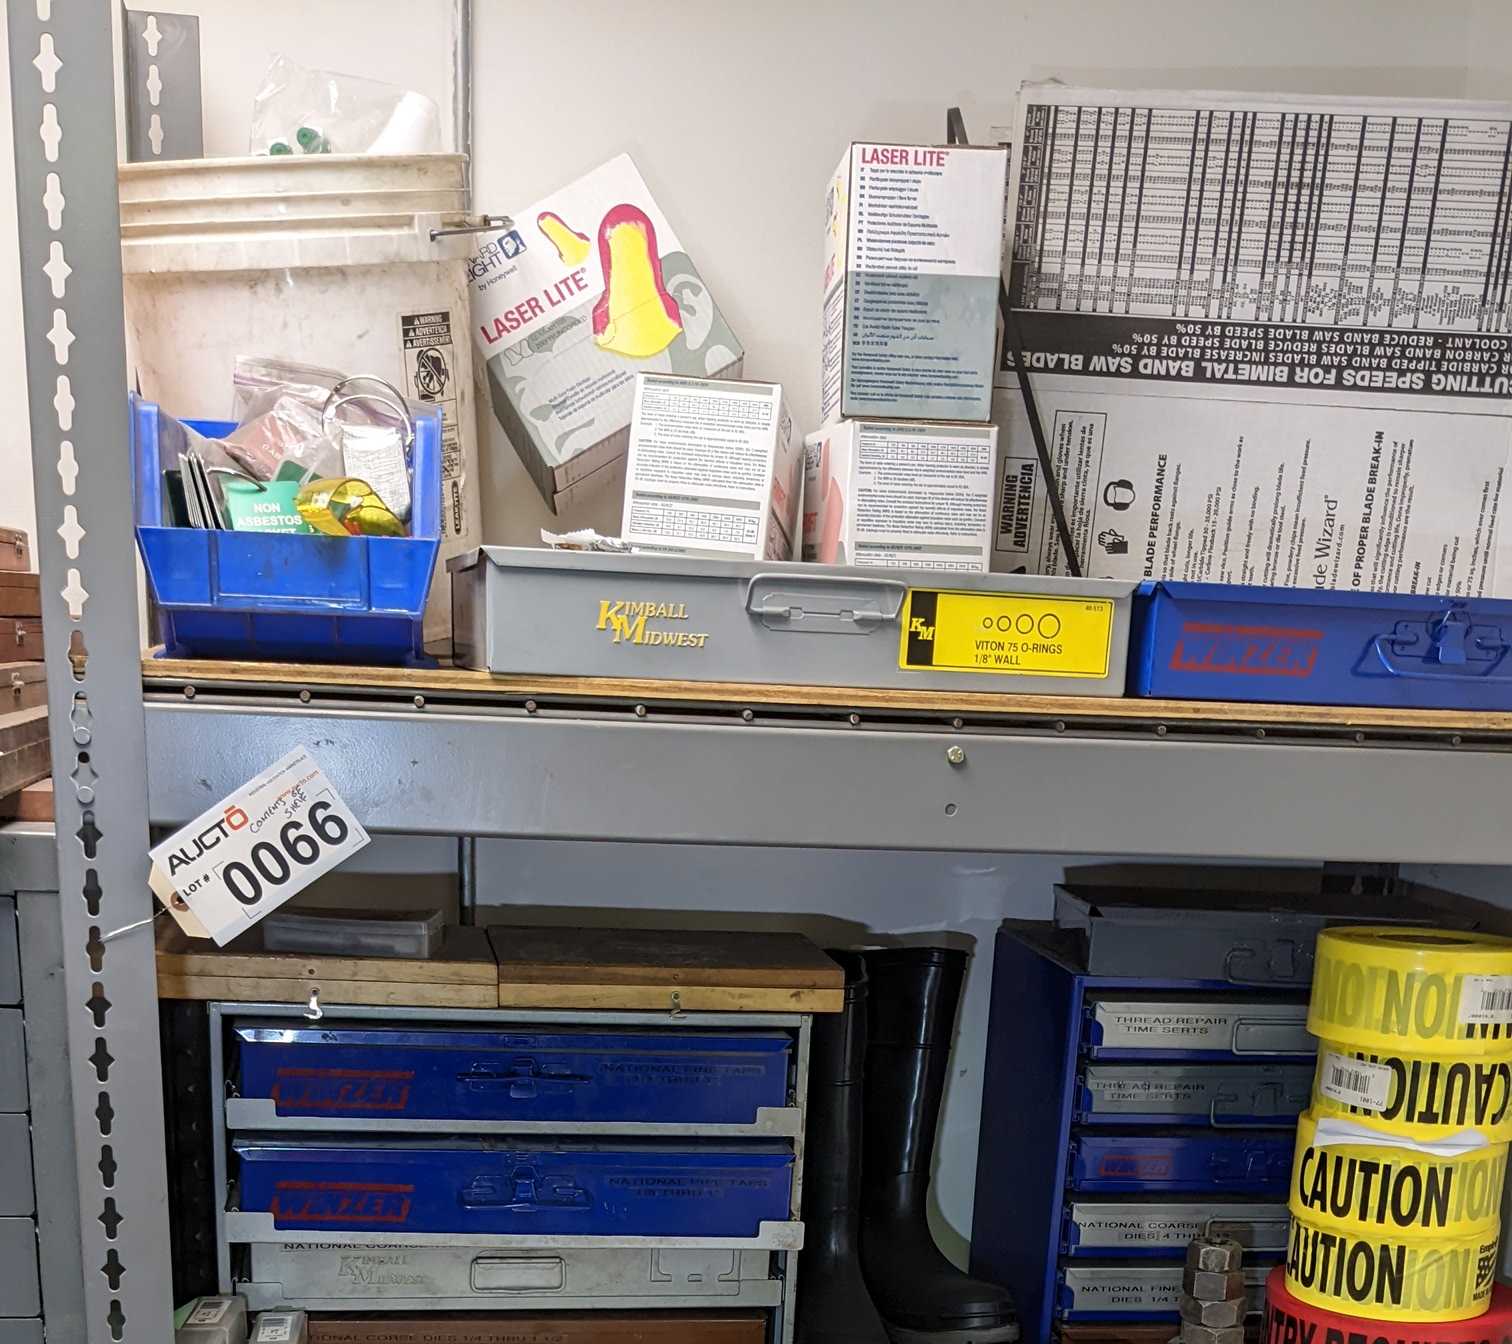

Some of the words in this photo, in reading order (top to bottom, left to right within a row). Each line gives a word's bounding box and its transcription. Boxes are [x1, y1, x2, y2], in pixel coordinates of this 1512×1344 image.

[862, 148, 909, 165] LASER
[478, 282, 488, 292] by
[485, 264, 518, 287] Honeywell
[478, 295, 546, 345] LASER
[1175, 321, 1201, 333] 50%
[1205, 323, 1221, 334] BY
[1224, 324, 1264, 337] SPEED
[1267, 326, 1308, 339] BLADE
[1312, 329, 1339, 341] SAW
[1131, 332, 1158, 343] 50%
[1161, 334, 1177, 344] BY
[1180, 335, 1220, 347] SPEED
[1223, 337, 1264, 349] BLADE
[1343, 331, 1379, 343] BAND
[1383, 333, 1433, 346] REDUCE
[1445, 336, 1507, 350] COOLANT
[1111, 343, 1138, 354] 50%
[1141, 344, 1156, 355] BY
[1160, 345, 1200, 357] BLADE
[1267, 339, 1317, 352] REDUCE
[1321, 341, 1369, 355] BLADES
[1373, 344, 1400, 356] SAW
[1404, 346, 1440, 359] BAND
[1204, 348, 1264, 361] INCREASE
[1268, 350, 1316, 363] BLADES
[1320, 353, 1347, 365] SAW
[1351, 355, 1387, 367] BAND
[1444, 348, 1499, 362] CARBON
[1088, 354, 1132, 373] SAW
[1137, 357, 1194, 376] BAND
[1391, 357, 1436, 370] TIPPED
[1441, 360, 1496, 374] CARBIDE
[1200, 360, 1288, 382] BIMETAL
[1294, 365, 1336, 384] FOR
[1342, 368, 1424, 389] SPEEDS
[1058, 422, 1066, 441] when
[1080, 425, 1087, 434] de
[1055, 443, 1065, 464] gloves
[1062, 447, 1070, 466] under
[1084, 445, 1092, 458] que
[1367, 430, 1384, 484] BREAK-IN
[1074, 456, 1083, 479] utilizar
[1083, 460, 1090, 468] ya
[1060, 467, 1068, 479] and
[1058, 481, 1067, 498] sharp
[1078, 487, 1087, 505] sierra
[1146, 453, 1168, 538] PERFORMANCE
[998, 473, 1018, 534] WARNING
[1011, 462, 1035, 547] ADVERTENCIA
[1069, 480, 1082, 517] importante
[1361, 485, 1375, 524] BLADE
[253, 503, 281, 514] NON
[1077, 506, 1084, 515] de
[237, 516, 303, 527] ASBESTOS
[1075, 516, 1084, 531] hoja
[1077, 527, 1088, 568] herramienta
[1353, 524, 1369, 569] PROPER
[1142, 539, 1157, 577] BLADE
[1351, 570, 1362, 587] OF
[596, 600, 688, 630] KIMBALL
[613, 615, 709, 647] MIDWEST
[975, 640, 1005, 652] VITON
[1007, 642, 1018, 652] 75
[1021, 643, 1063, 655] O-RINGS
[994, 655, 1021, 665] WALL
[222, 800, 349, 907] 0066
[182, 880, 203, 897] LOT
[1115, 1016, 1172, 1025] THREAD
[1176, 1017, 1228, 1025] REPAIR
[1162, 1026, 1209, 1035] SERTS
[1300, 1147, 1453, 1228] CAUTION
[1079, 1221, 1143, 1230] NATIONAL
[1123, 1231, 1155, 1240] DIES
[1288, 1218, 1406, 1305] AUTION
[1081, 1285, 1146, 1294] NATIONAL
